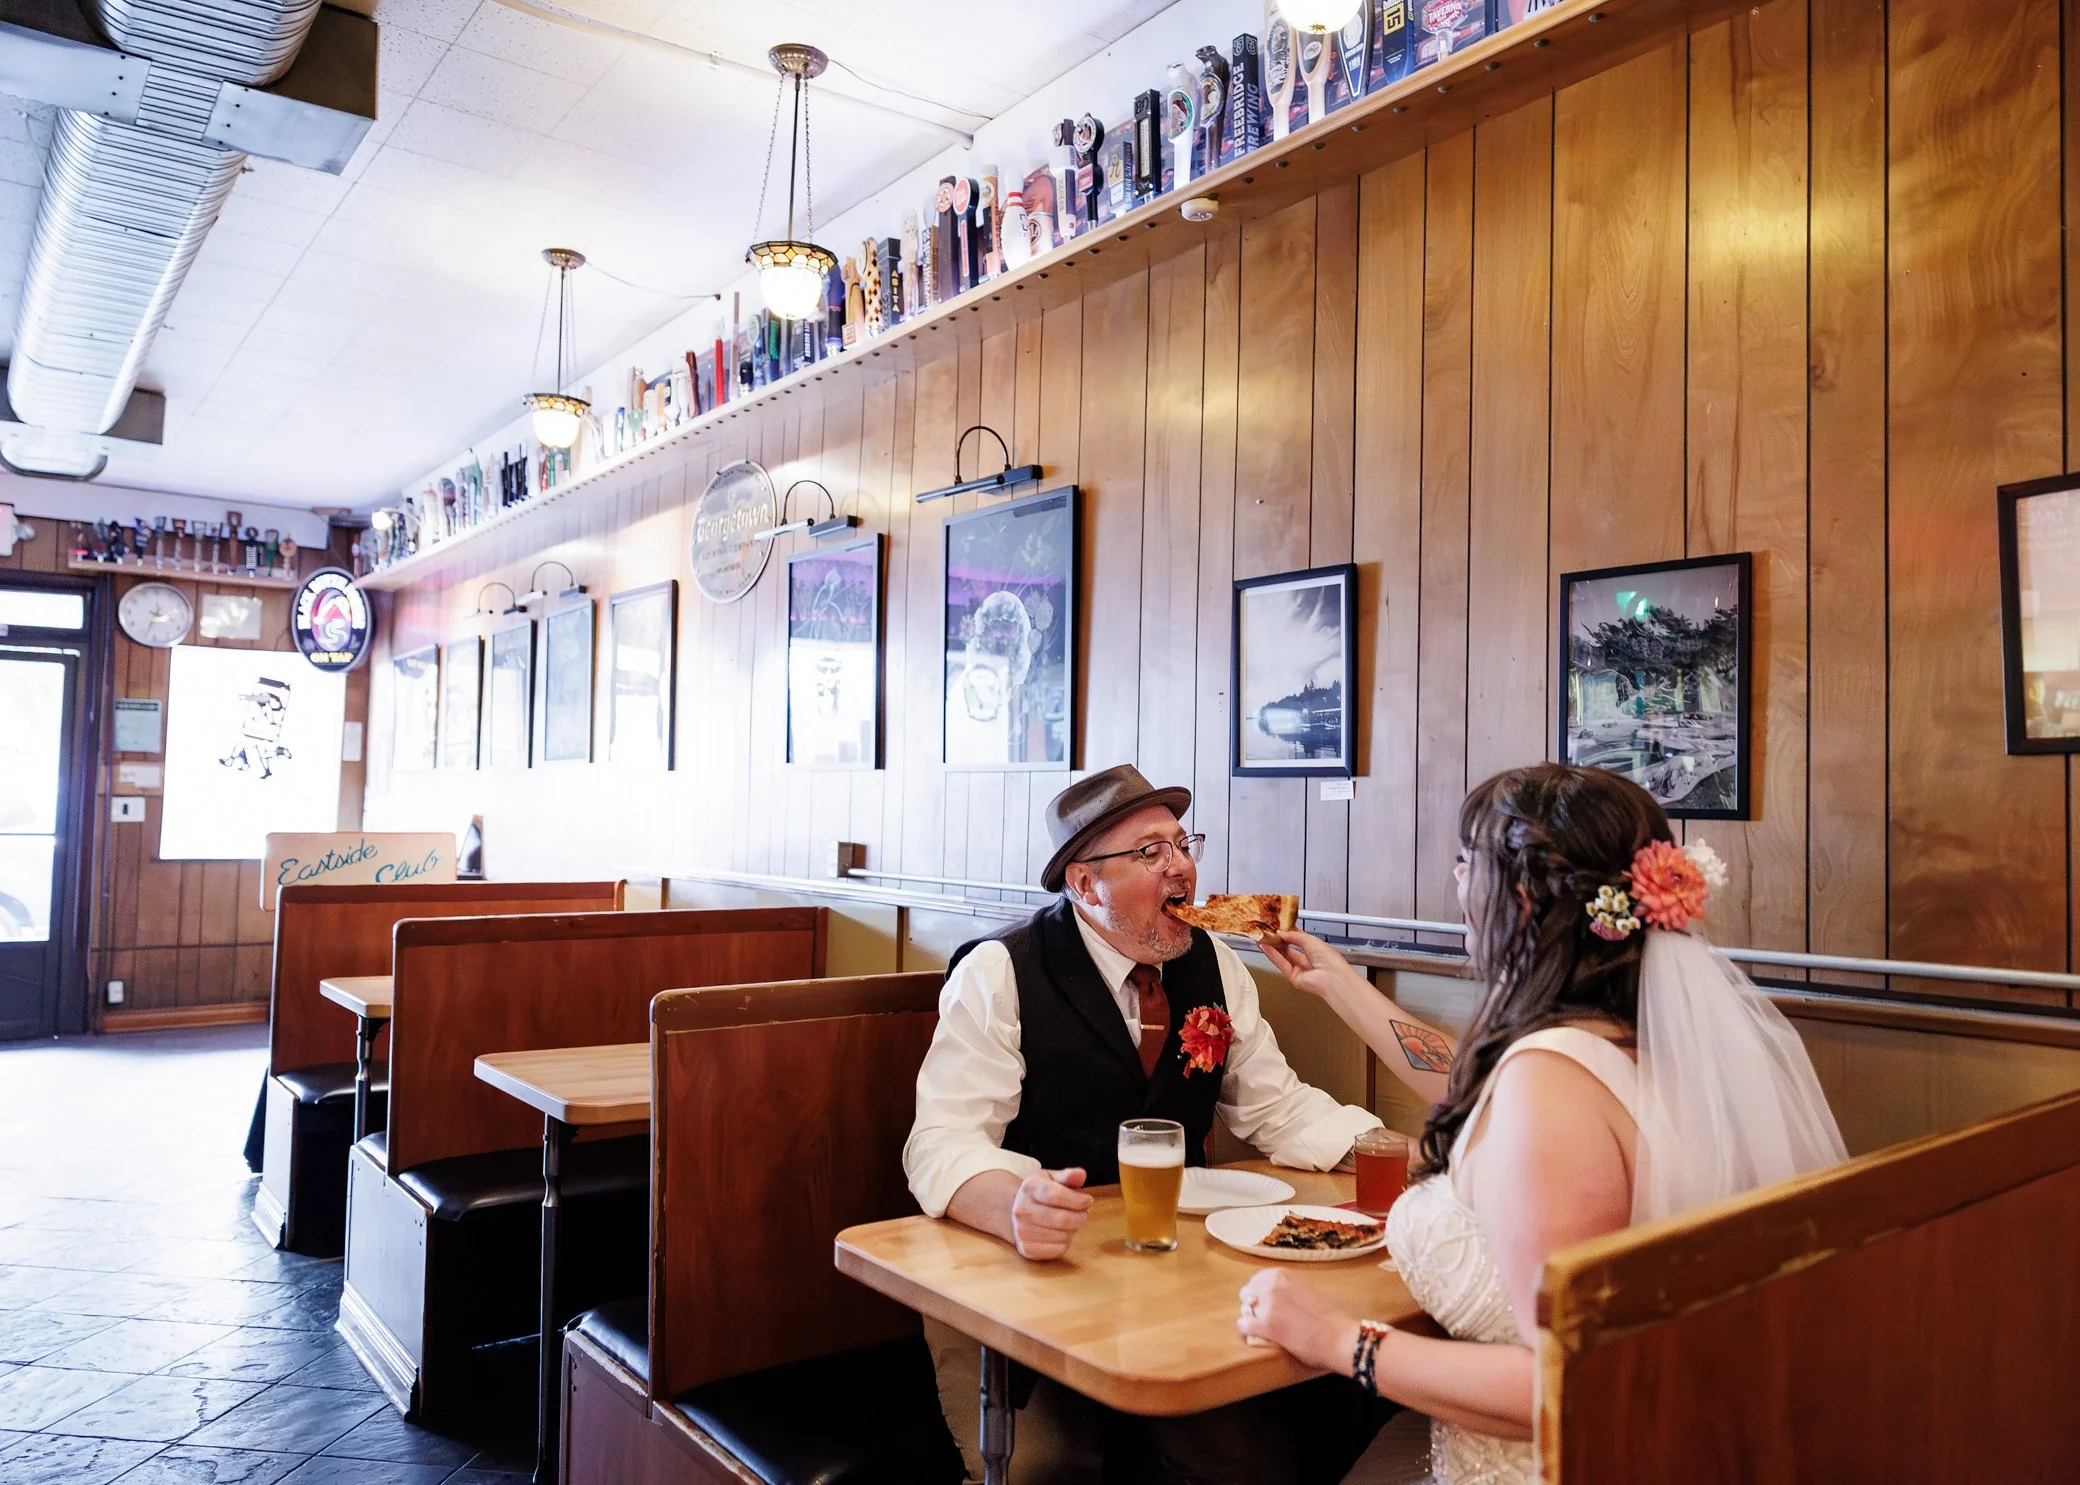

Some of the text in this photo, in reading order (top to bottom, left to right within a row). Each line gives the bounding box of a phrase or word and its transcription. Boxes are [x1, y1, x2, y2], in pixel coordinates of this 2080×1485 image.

[1233, 62, 1246, 158] FREEBRIDGE
[891, 270, 900, 312] ABITA
[278, 838, 439, 884] Eastside Club
